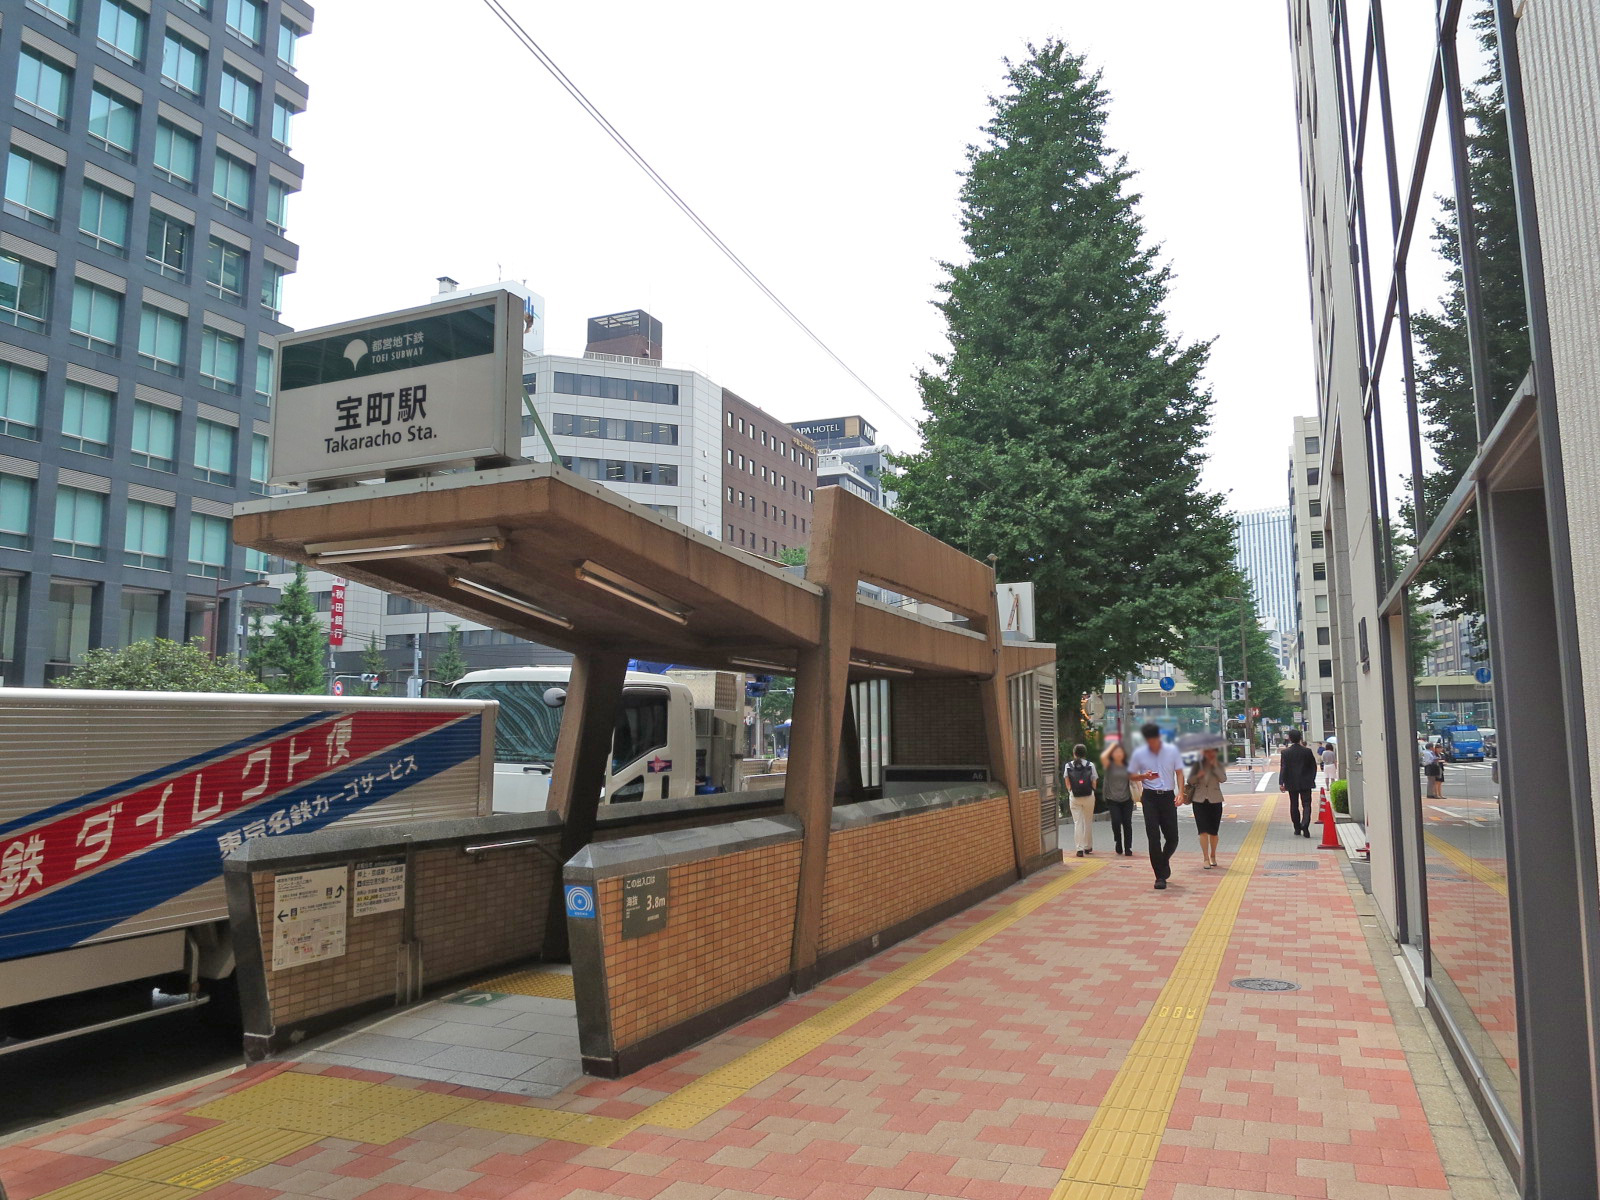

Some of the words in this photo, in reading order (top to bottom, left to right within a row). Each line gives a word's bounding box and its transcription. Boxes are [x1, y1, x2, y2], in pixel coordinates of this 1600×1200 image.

[372, 332, 424, 352] 都営地下鉄
[372, 353, 388, 364] TOEI
[391, 347, 424, 361] SUBWAY
[334, 384, 427, 432] 宝町駅
[812, 423, 840, 433] HOTEL
[863, 423, 875, 443] APA
[324, 430, 402, 453] Takaracho
[407, 425, 438, 442] Sta.
[335, 590, 344, 638] 秋田銀行
[972, 772, 984, 780] A6
[217, 755, 418, 859] 東京名鉄カーゴサービス
[646, 895, 666, 911] 3.8m
